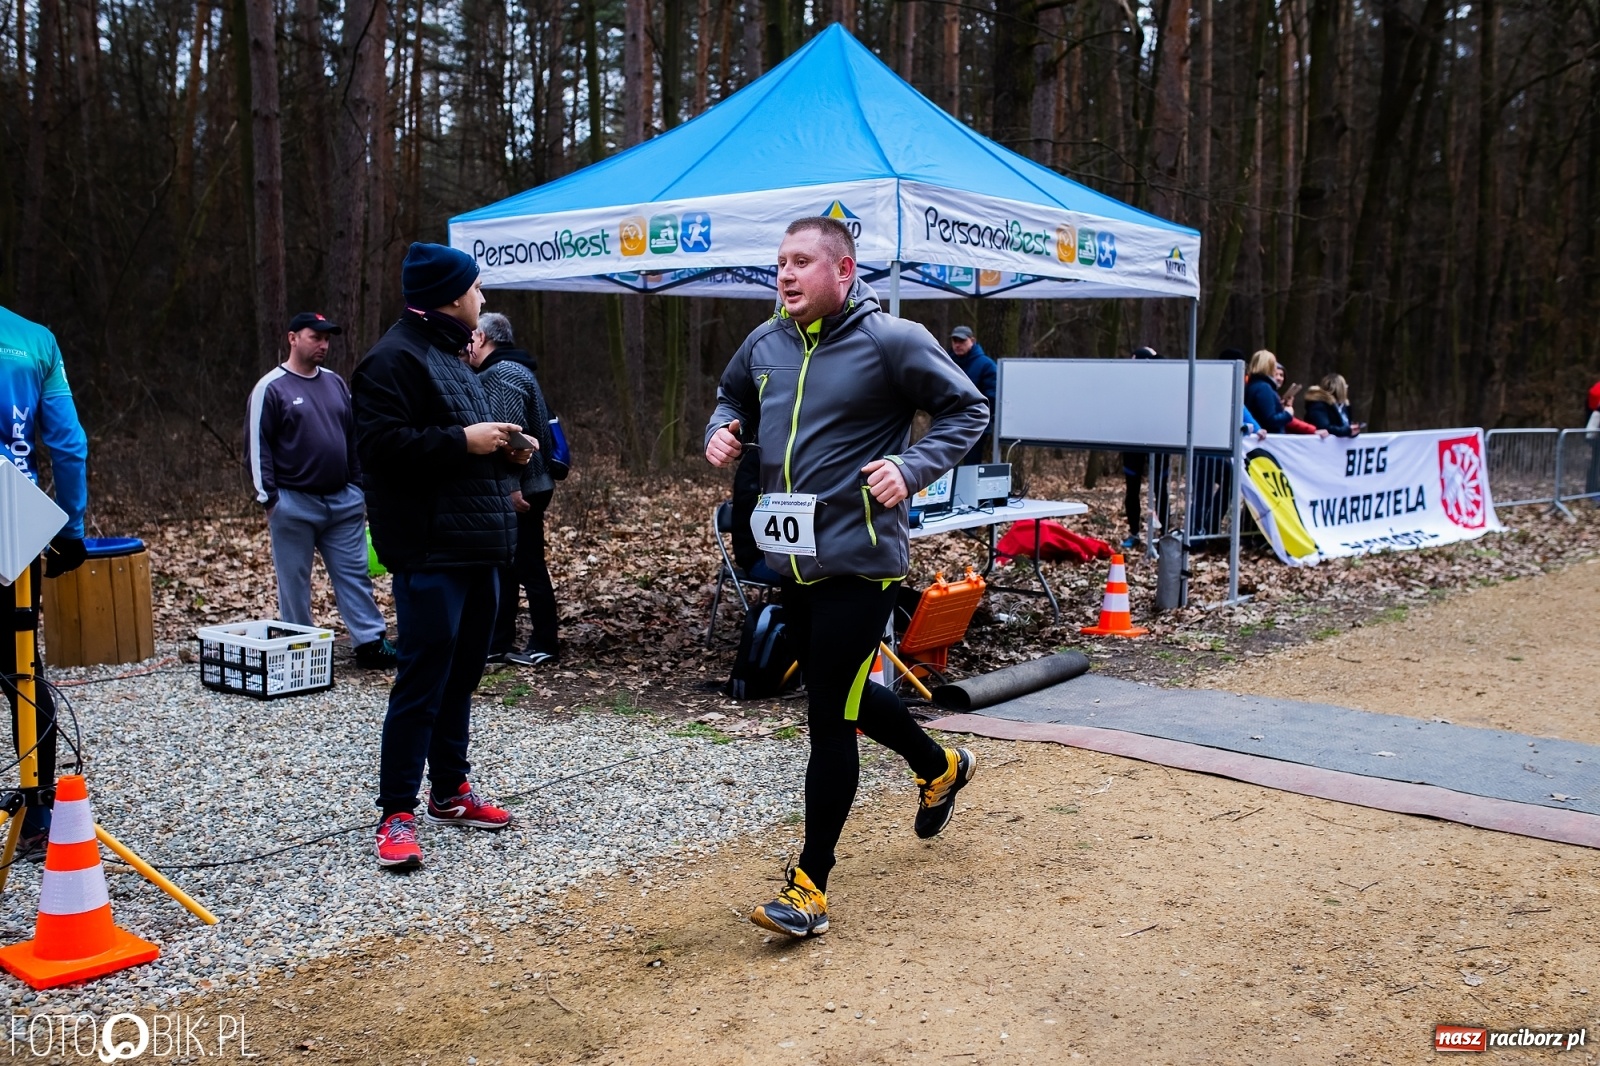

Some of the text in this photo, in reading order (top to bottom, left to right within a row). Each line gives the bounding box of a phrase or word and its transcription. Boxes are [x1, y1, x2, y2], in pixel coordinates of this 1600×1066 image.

[473, 229, 611, 267] PersonalBest
[925, 206, 1051, 256] PersonalBest
[1345, 446, 1388, 477] BIEG
[1309, 485, 1426, 528] TWARDZIELA
[764, 515, 799, 543] 40
